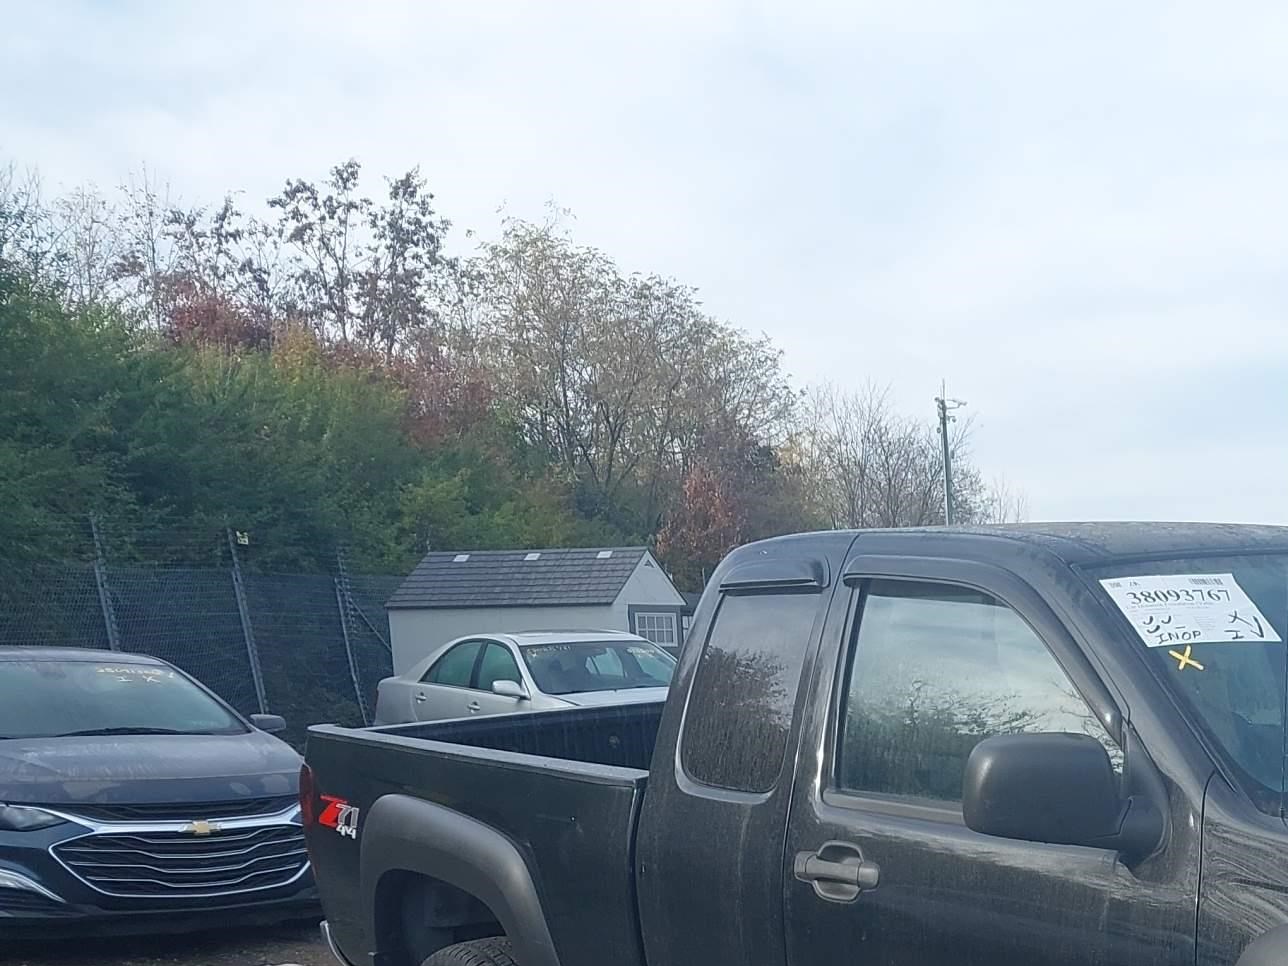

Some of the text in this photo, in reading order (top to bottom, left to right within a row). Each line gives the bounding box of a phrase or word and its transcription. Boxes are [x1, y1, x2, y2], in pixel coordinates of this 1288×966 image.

[1126, 589, 1231, 604] 38093767
[1155, 630, 1202, 645] INOP
[319, 794, 360, 829] Z71
